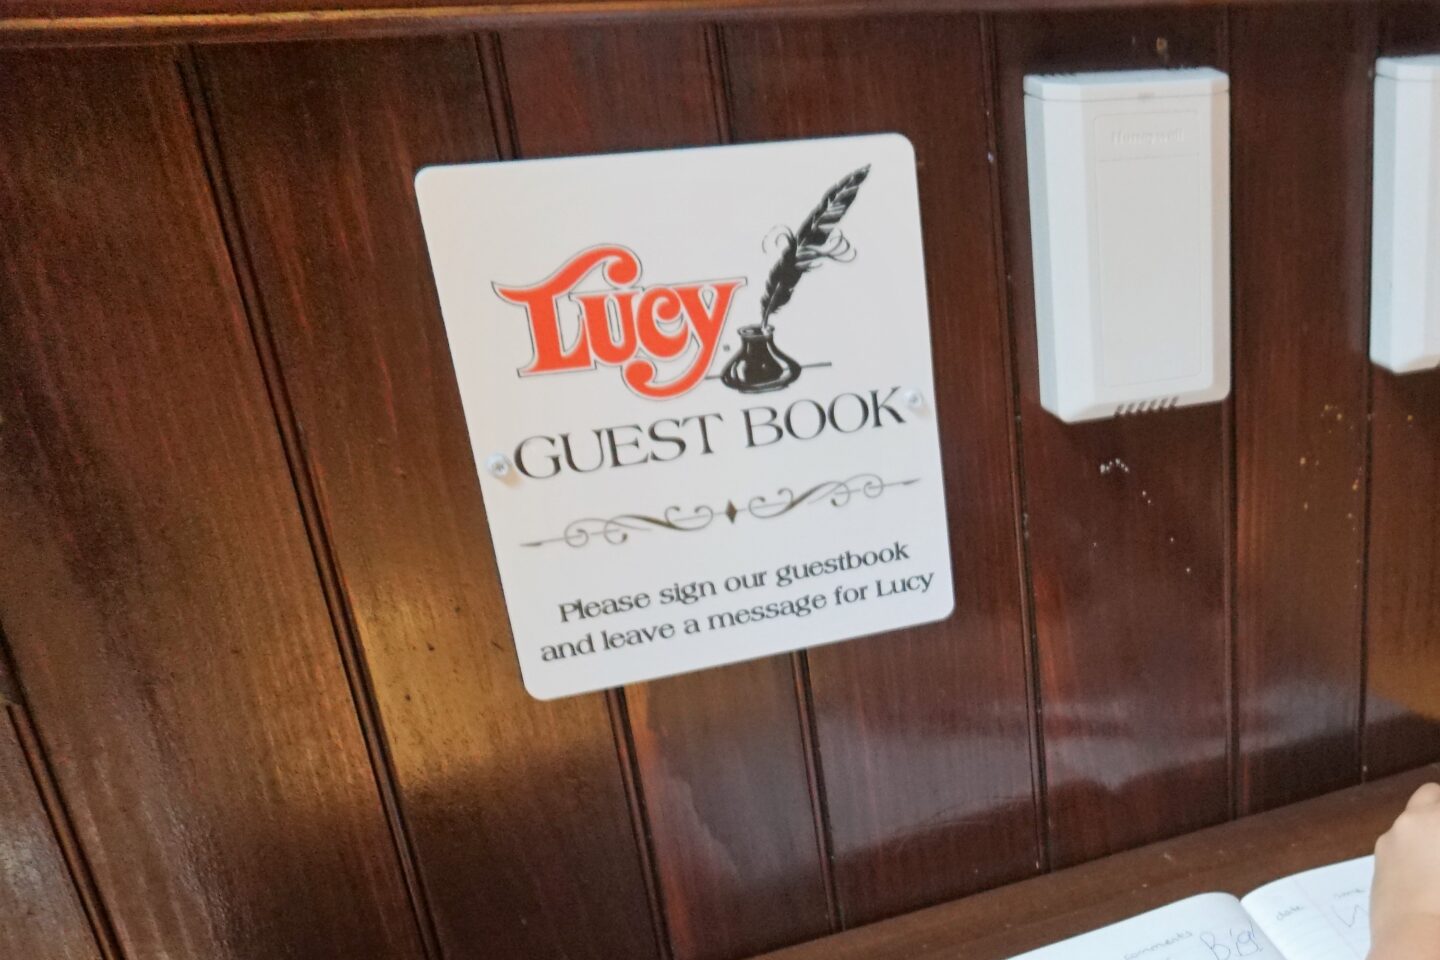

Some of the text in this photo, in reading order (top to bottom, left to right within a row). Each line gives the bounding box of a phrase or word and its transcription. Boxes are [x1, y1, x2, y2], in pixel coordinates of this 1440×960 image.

[490, 243, 747, 400] Lucy
[513, 385, 907, 480] GUEST BOOK
[541, 570, 935, 663] and leave a message for Lucy
[558, 540, 910, 623] Please sign our guestbook
